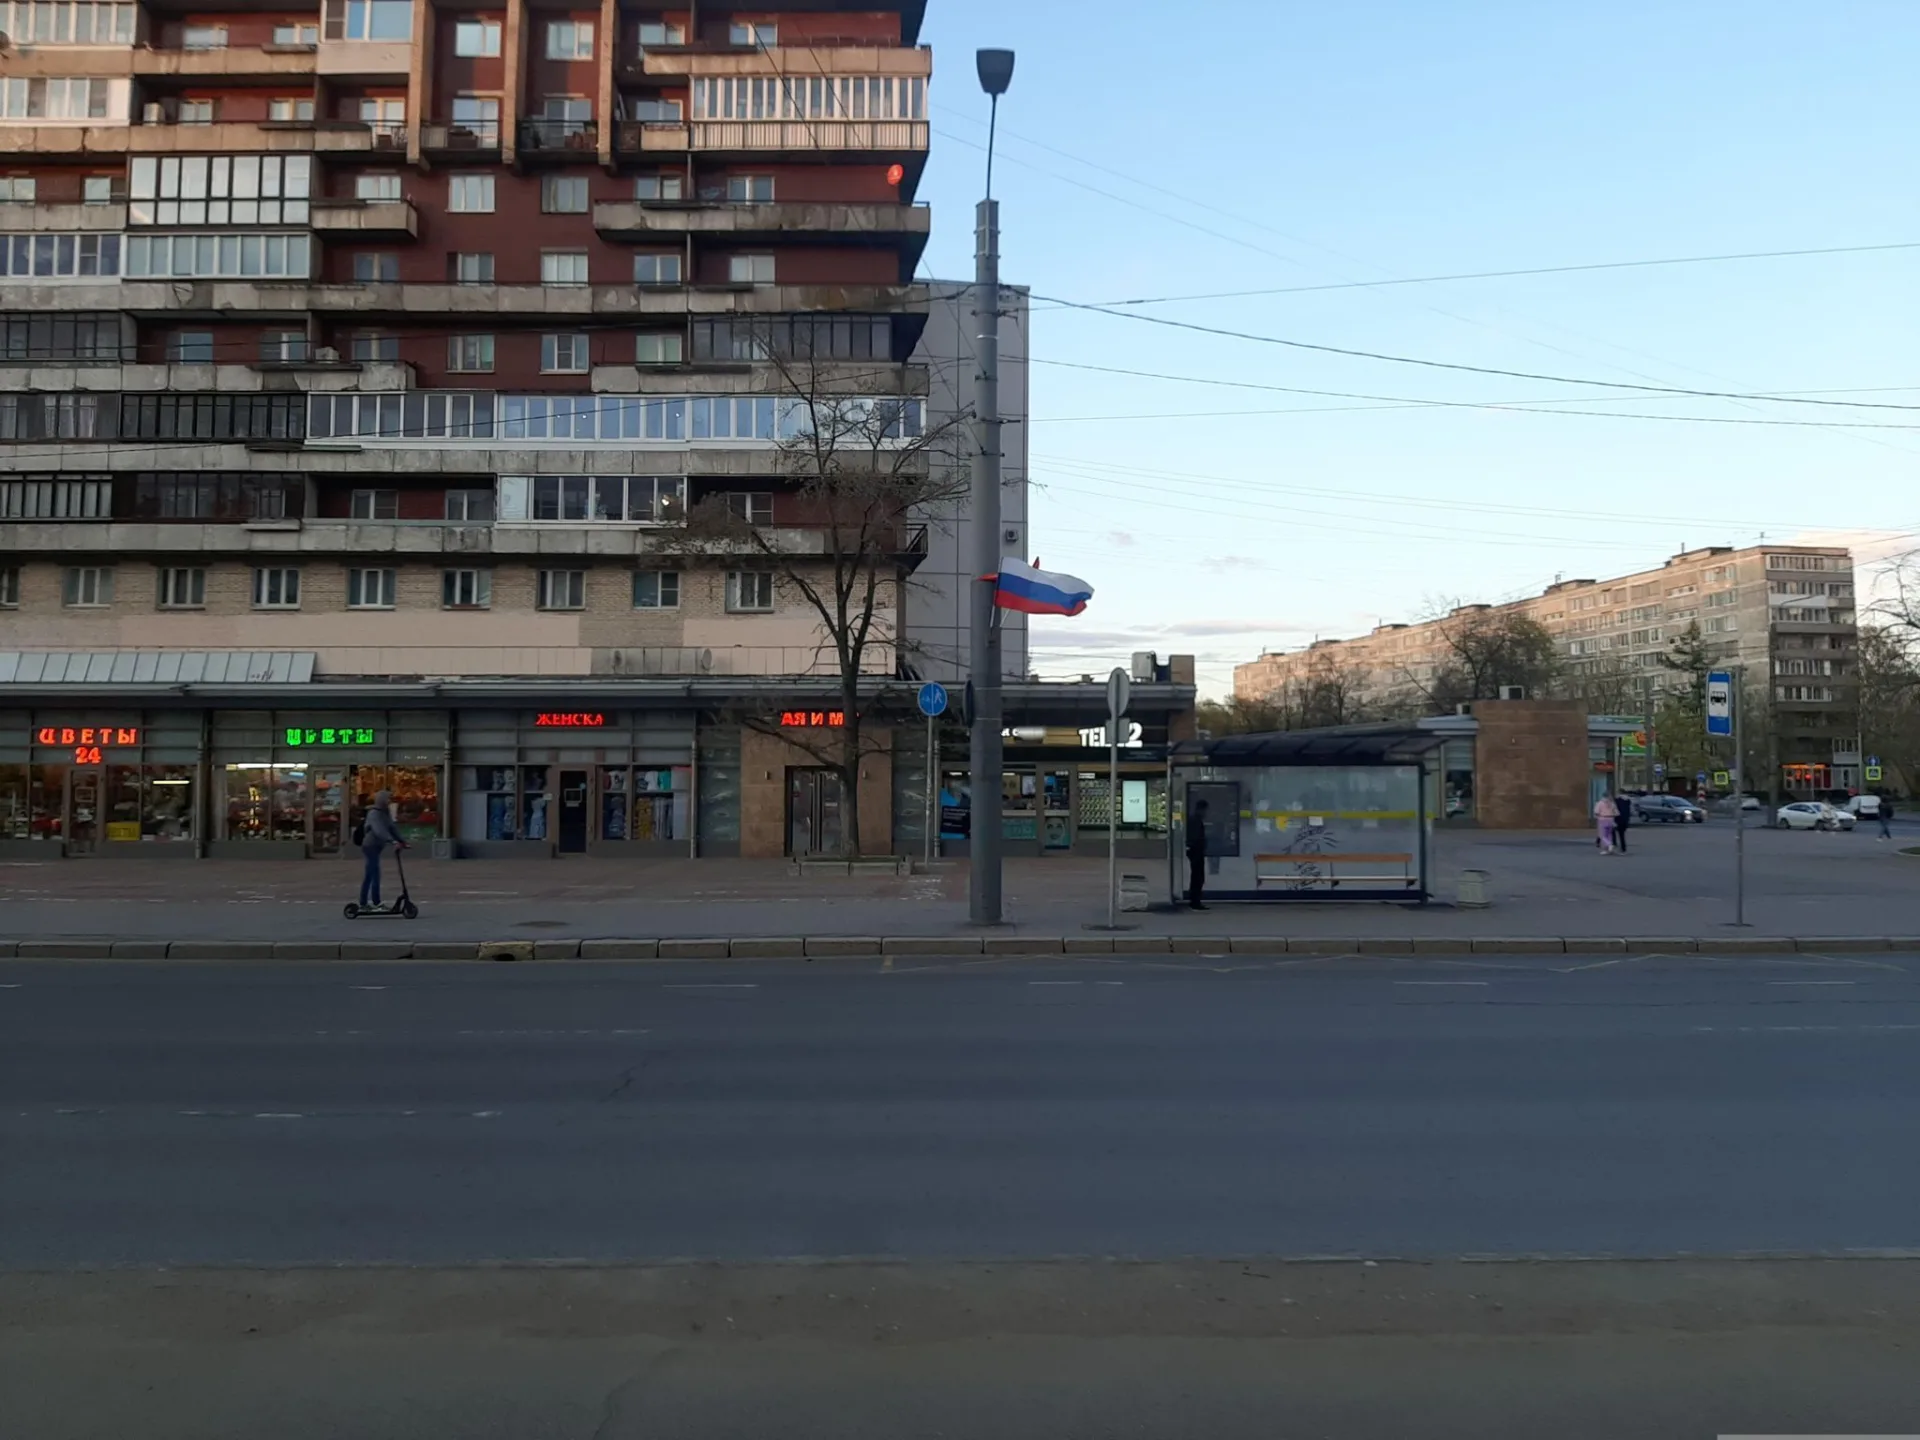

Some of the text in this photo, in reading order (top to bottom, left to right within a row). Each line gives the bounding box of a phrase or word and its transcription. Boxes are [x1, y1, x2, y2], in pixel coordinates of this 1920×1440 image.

[39, 728, 137, 745] ЦВЕТЫ
[1078, 722, 1143, 748] TEL2
[75, 746, 101, 764] 24
